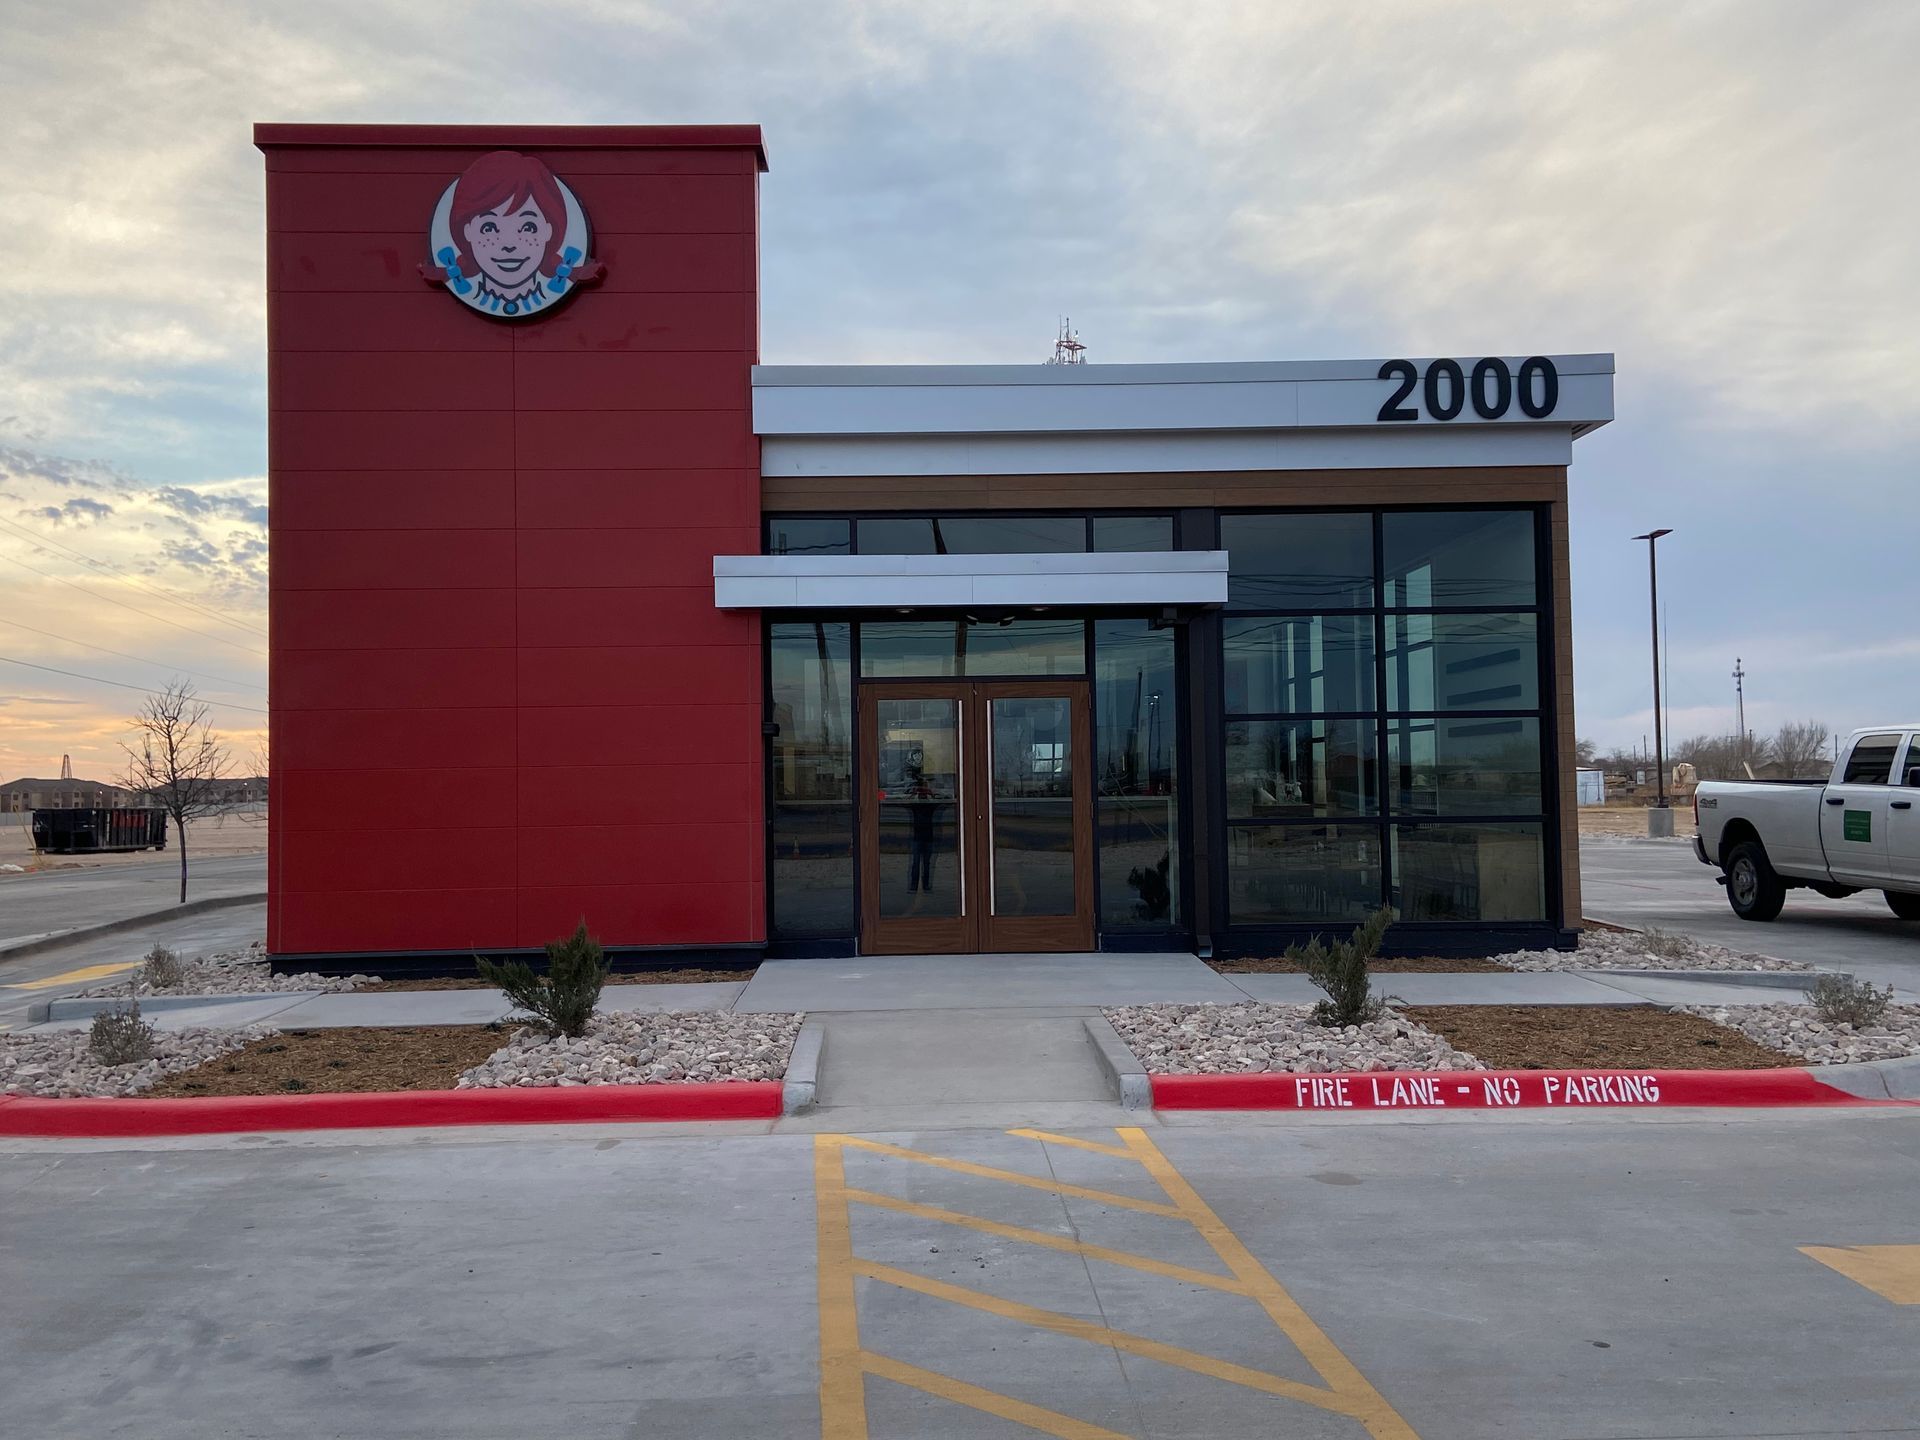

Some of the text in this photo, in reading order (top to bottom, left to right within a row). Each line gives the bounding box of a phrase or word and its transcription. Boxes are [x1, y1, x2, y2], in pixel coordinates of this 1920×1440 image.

[1377, 356, 1559, 422] 2000
[1295, 1075, 1660, 1107] FIRE LANE - NO PARKING
